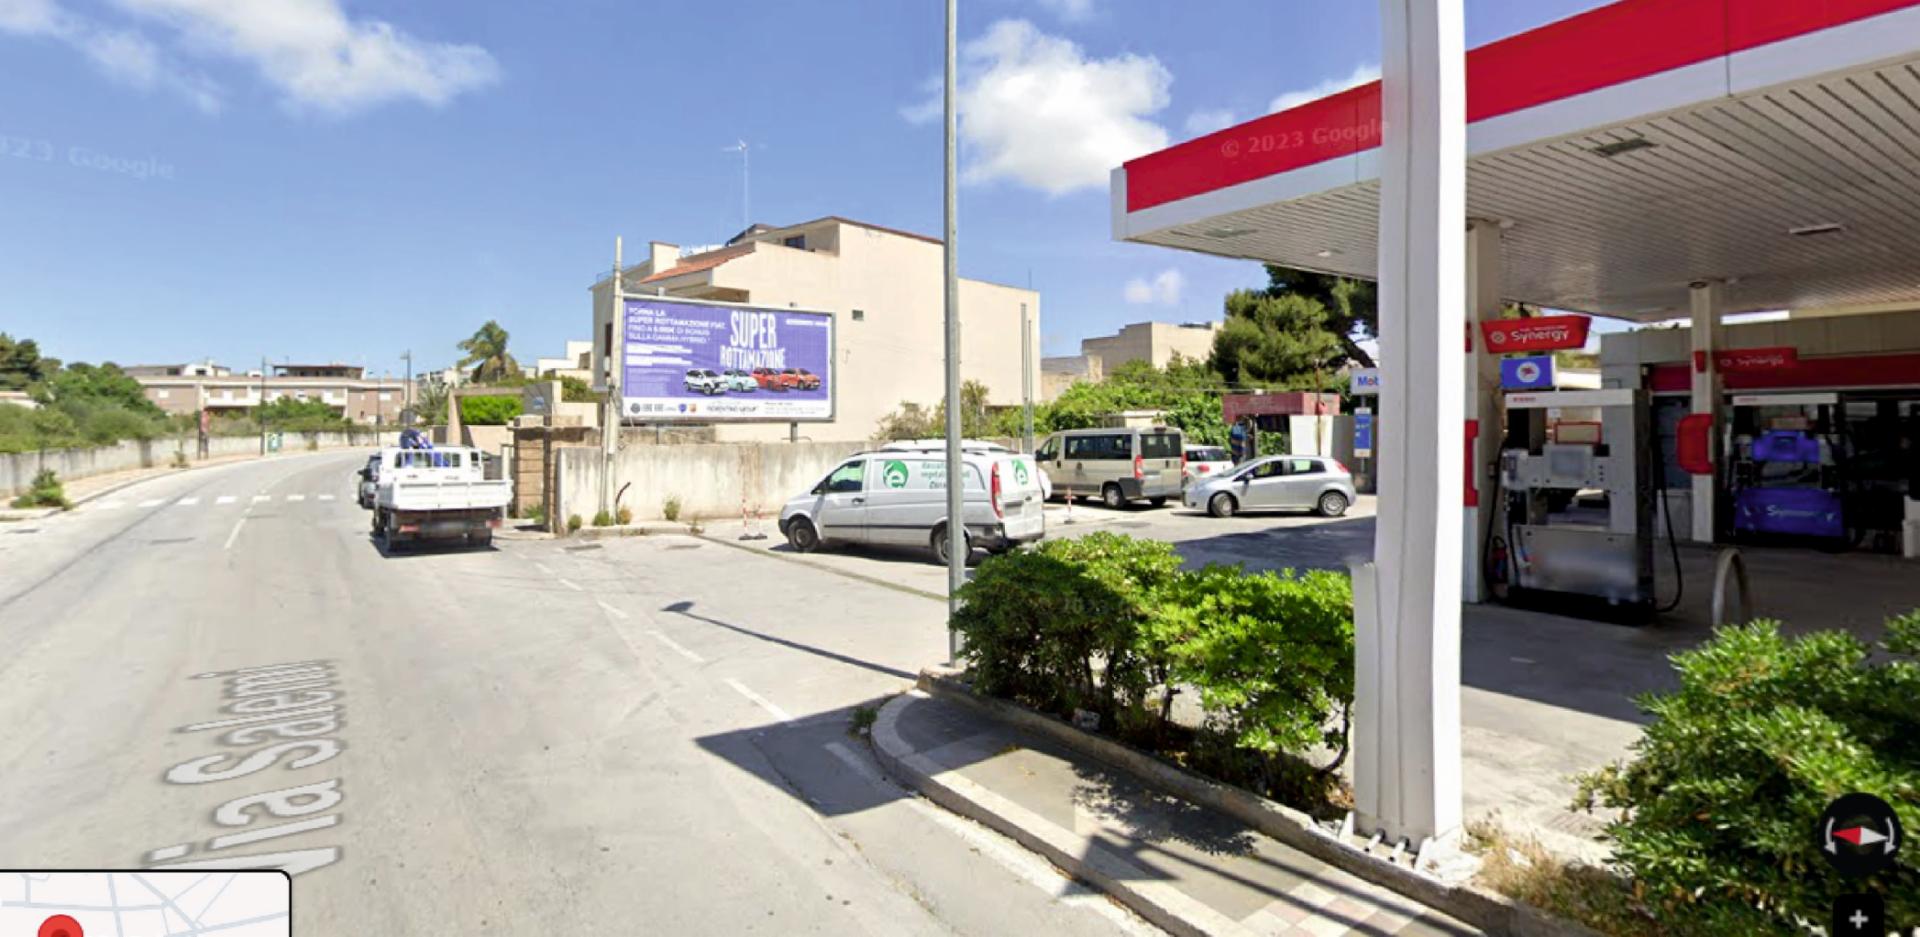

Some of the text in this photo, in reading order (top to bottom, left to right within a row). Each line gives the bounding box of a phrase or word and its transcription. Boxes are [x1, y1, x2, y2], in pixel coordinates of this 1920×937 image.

[730, 310, 777, 349] SUPER
[1511, 329, 1569, 345] Synergy
[720, 345, 785, 369] ROTTAMAZIONE
